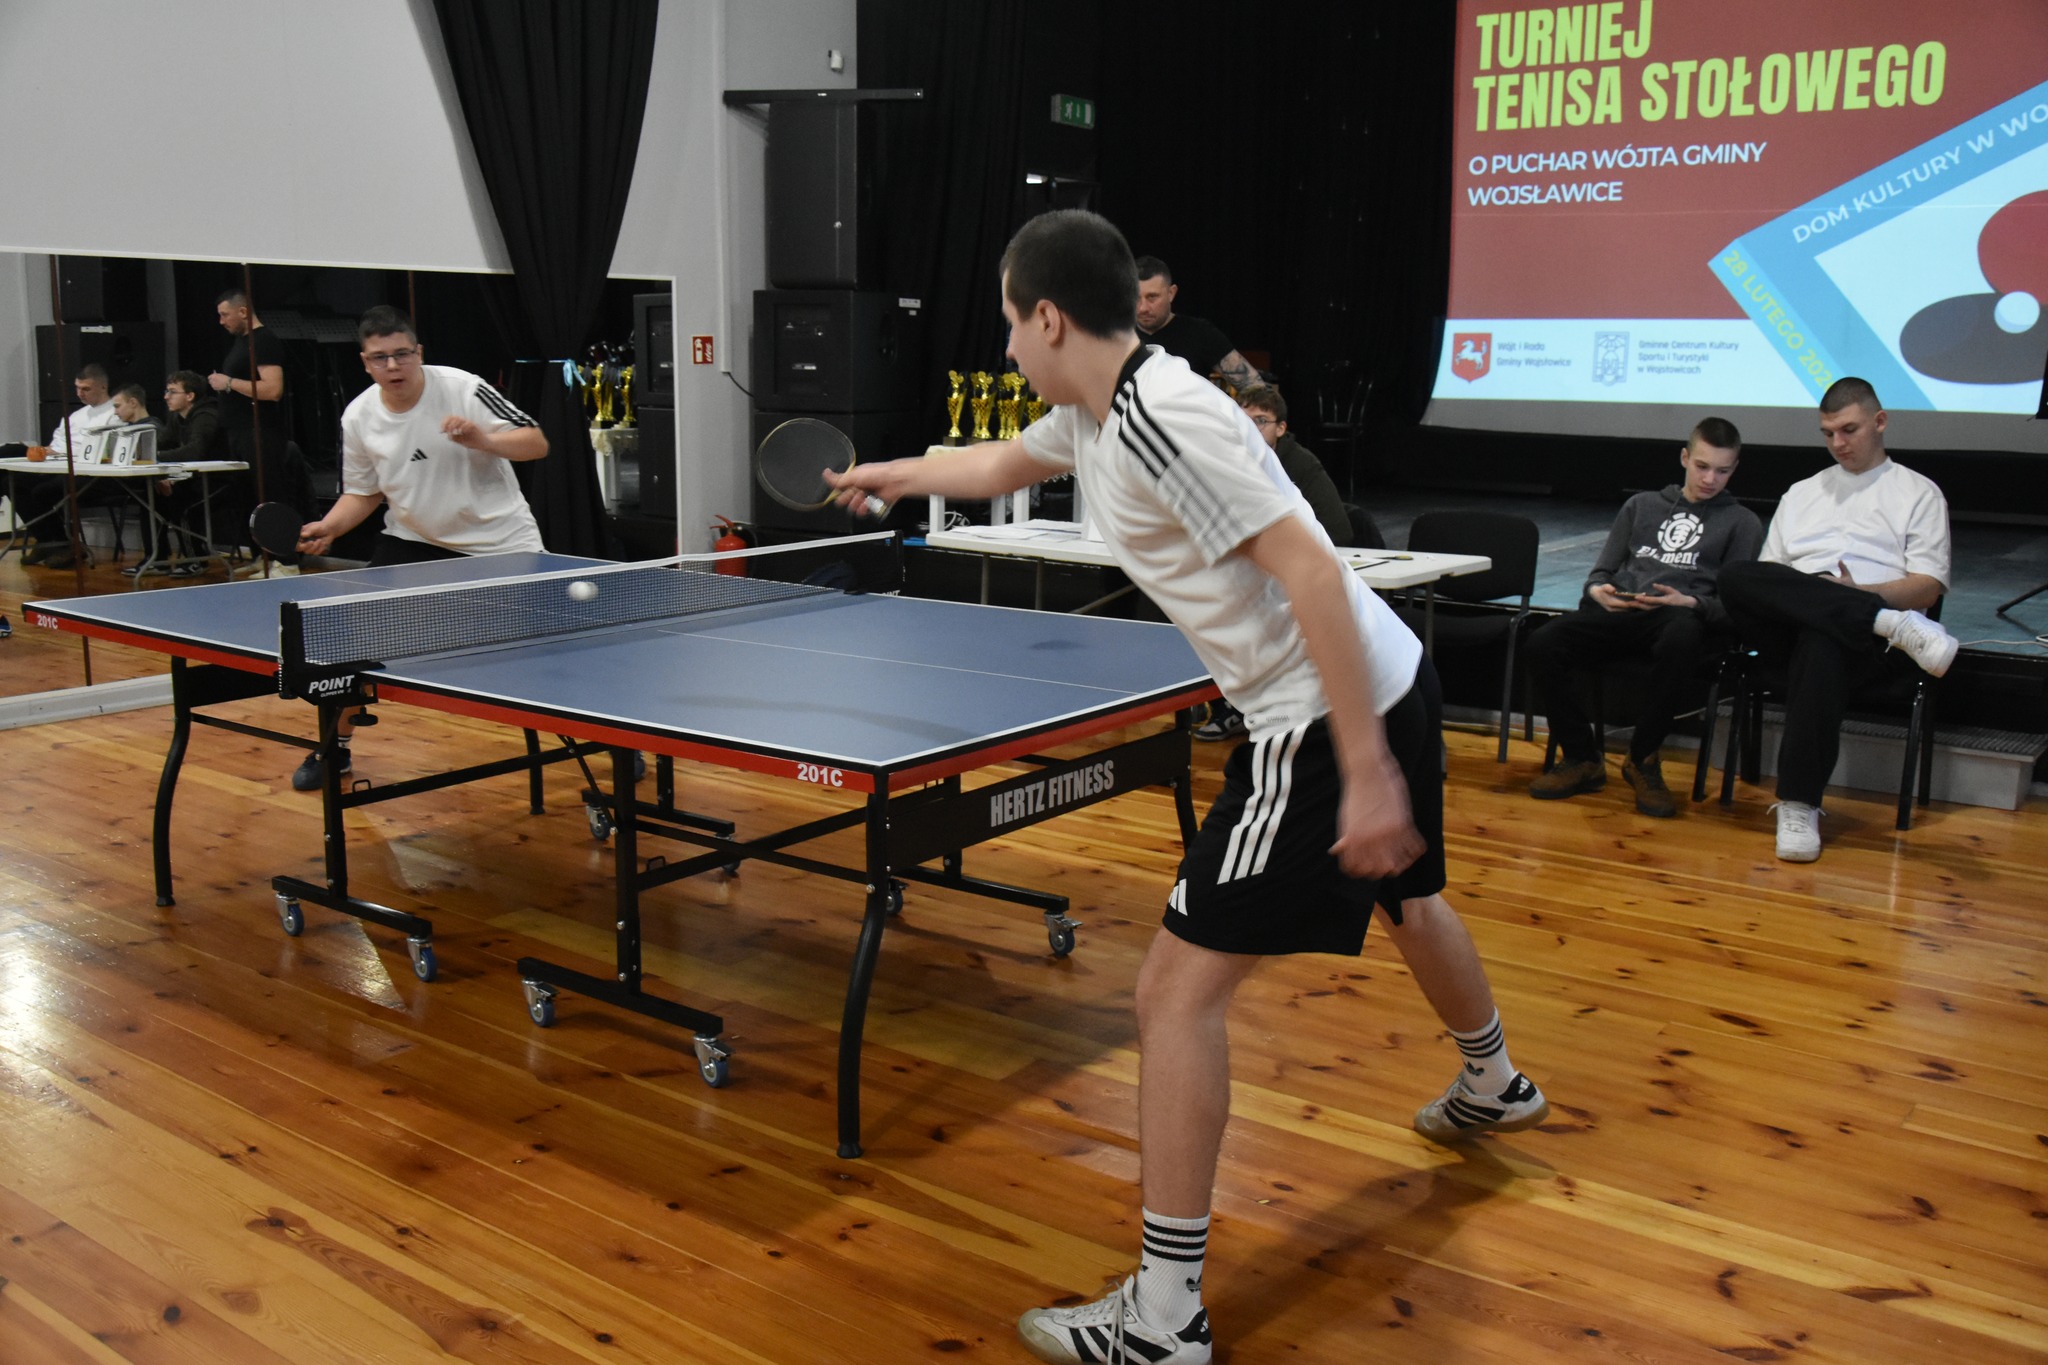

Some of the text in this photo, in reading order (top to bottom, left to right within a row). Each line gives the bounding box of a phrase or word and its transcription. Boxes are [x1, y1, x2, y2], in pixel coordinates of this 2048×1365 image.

[1475, 0, 1654, 70] TURNIEJ
[1472, 41, 1947, 132] TENISA STOŁOWEGO
[1468, 142, 1767, 175] O PUCHAR WÓJTA GMINY
[1467, 181, 1623, 206] WOJSŁAWICE
[1792, 204, 1849, 243] DOM
[1852, 146, 1961, 213] KULTURY
[1966, 129, 1995, 154] W
[1722, 249, 1749, 277] 28
[1742, 274, 1805, 350] LUTEGO
[37, 614, 58, 630] 201C
[308, 675, 355, 694] POINT
[797, 763, 843, 787] 201C
[990, 760, 1114, 828] HERTZ FITNESS
